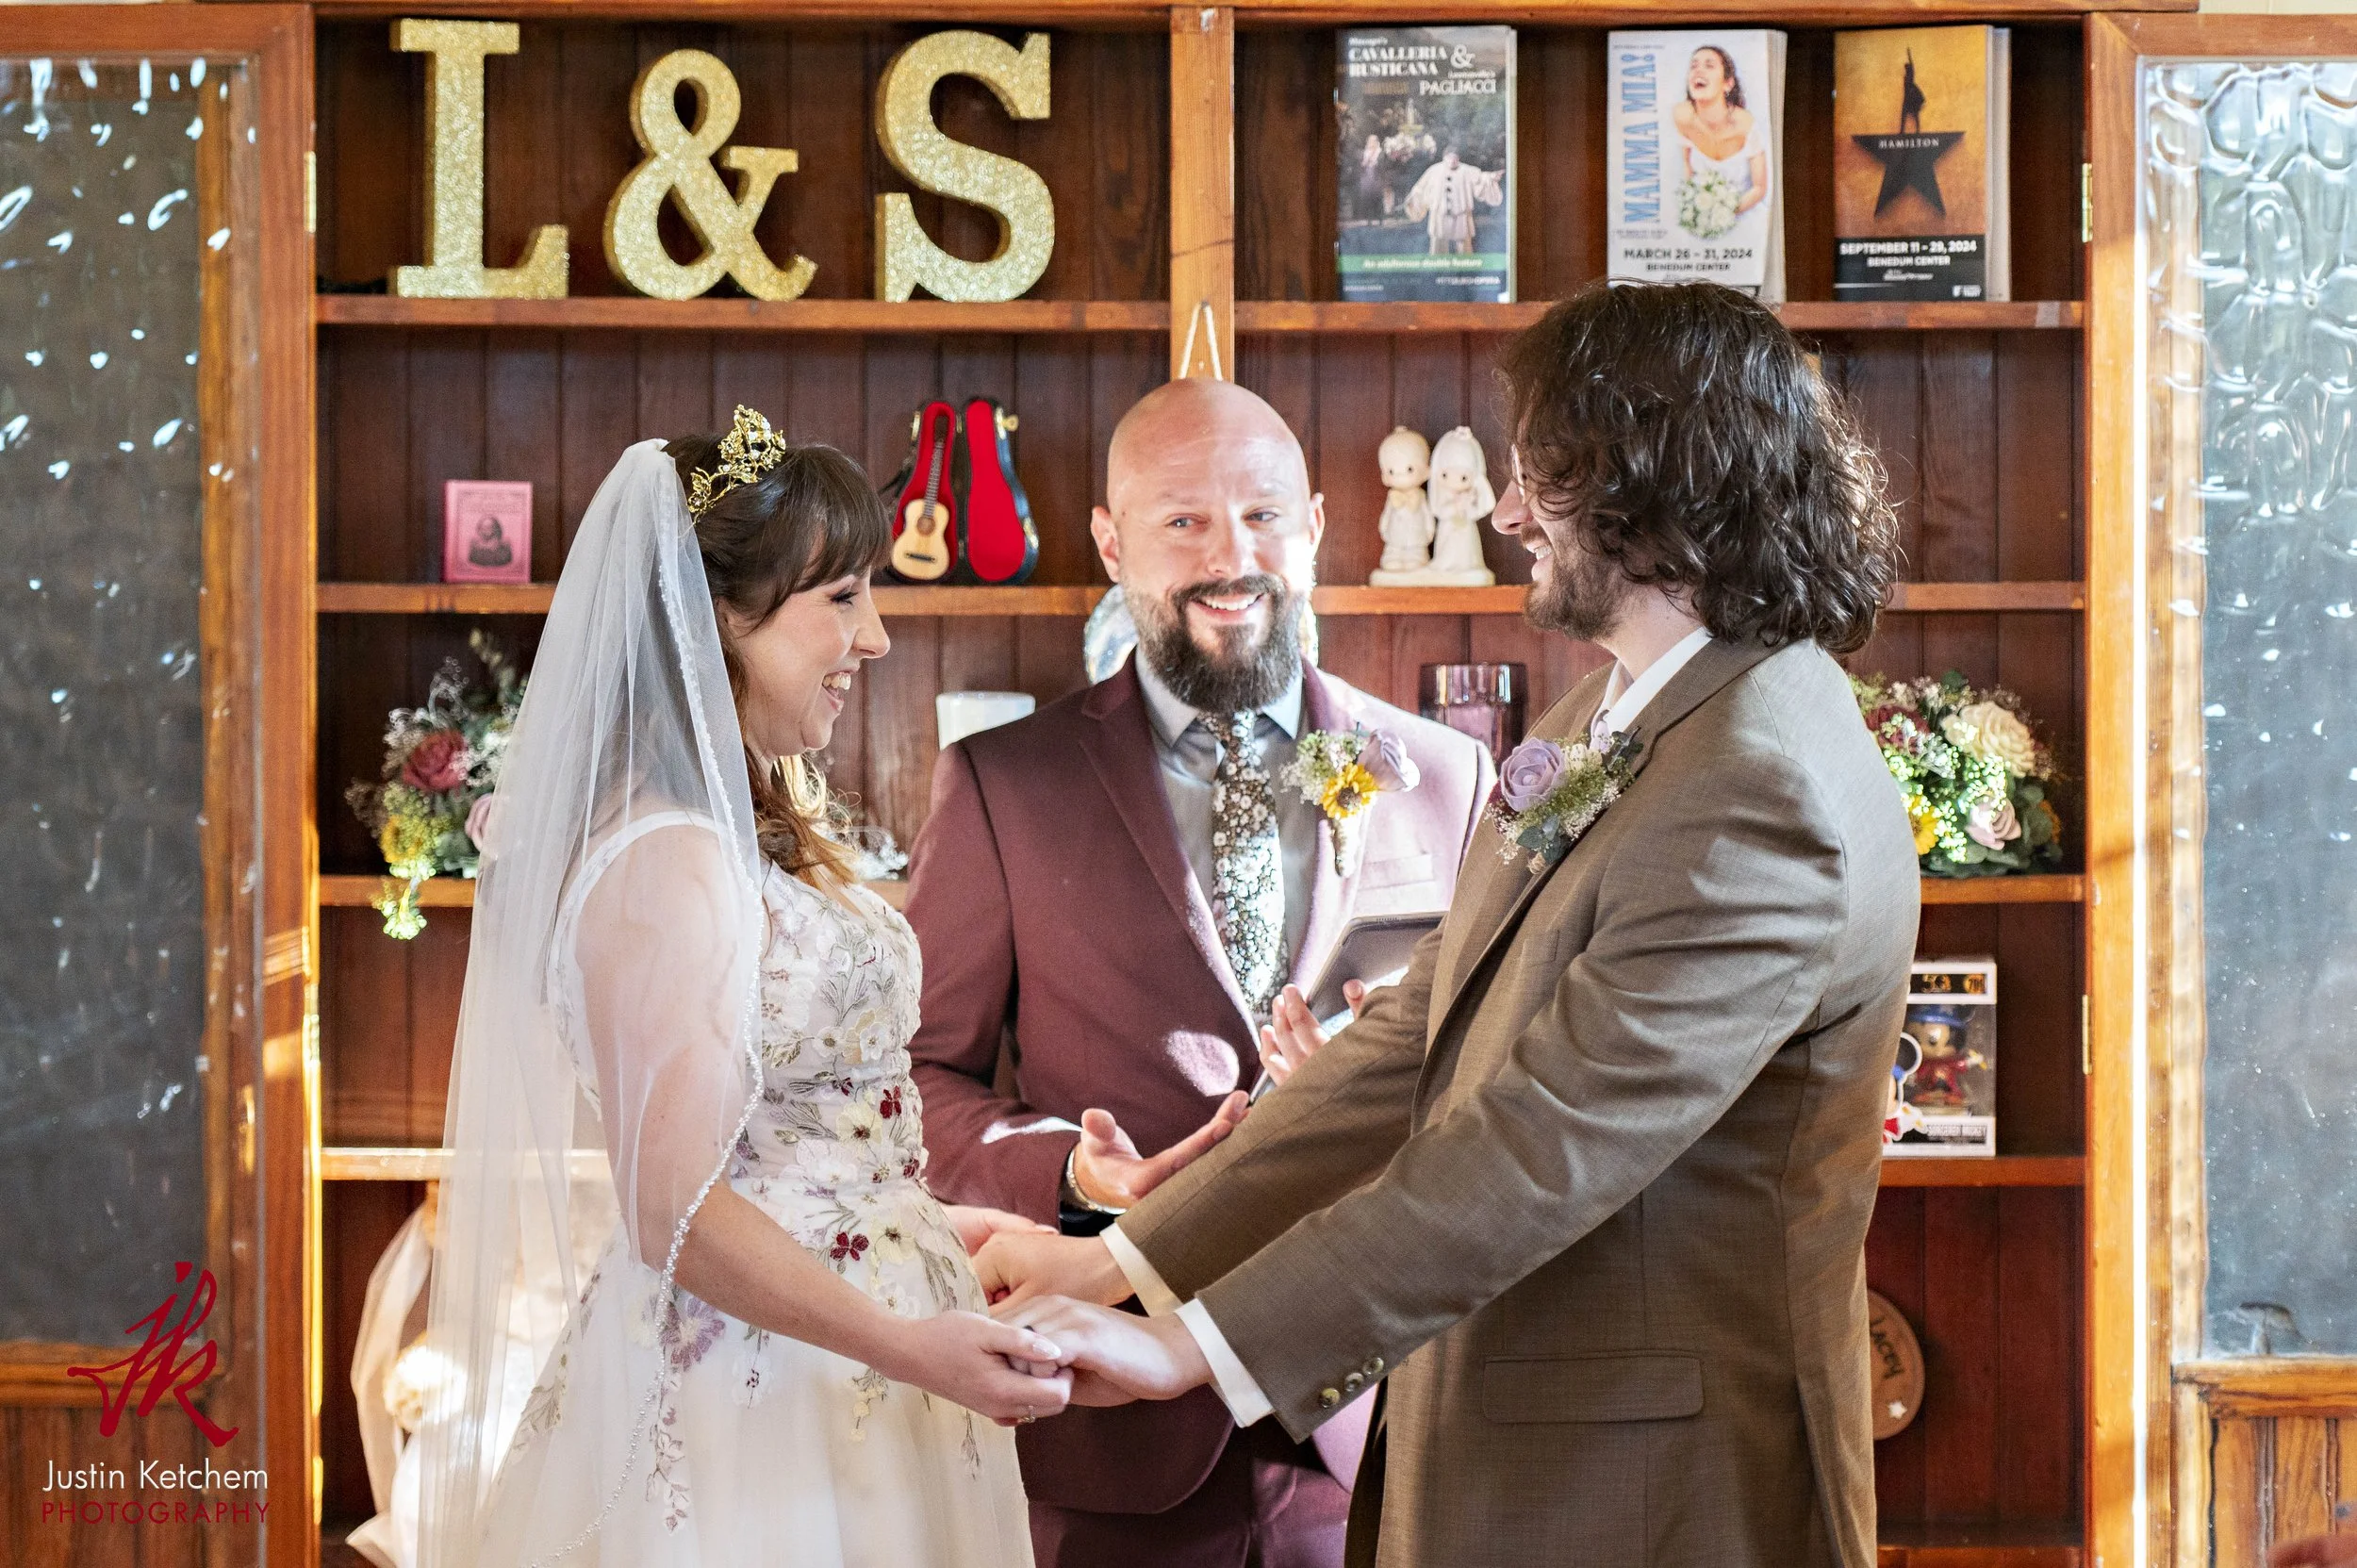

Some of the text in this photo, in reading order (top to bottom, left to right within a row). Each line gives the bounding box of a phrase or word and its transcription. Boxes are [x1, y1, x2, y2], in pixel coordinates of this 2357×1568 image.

[1348, 45, 1447, 61] CAVALLERIA
[1450, 43, 1475, 69] &
[1348, 61, 1439, 77] RUSTICANA
[1419, 78, 1497, 95] PAGLIACCI
[1621, 52, 1658, 114] MIA!
[1879, 138, 1939, 149] HAMILTON
[390, 18, 1055, 302] L & S
[1623, 121, 1661, 223] MAMMA
[1624, 248, 1672, 259] MARCH
[1675, 248, 1690, 259] 26
[1722, 248, 1754, 259] 2024
[1839, 241, 1909, 255] SEPTEMBER
[1910, 241, 1920, 253] 11
[1948, 239, 1977, 253] 2024
[1646, 262, 1731, 272] BENEDUM CENTER
[1867, 256, 1951, 267] BENEDUM CENTER
